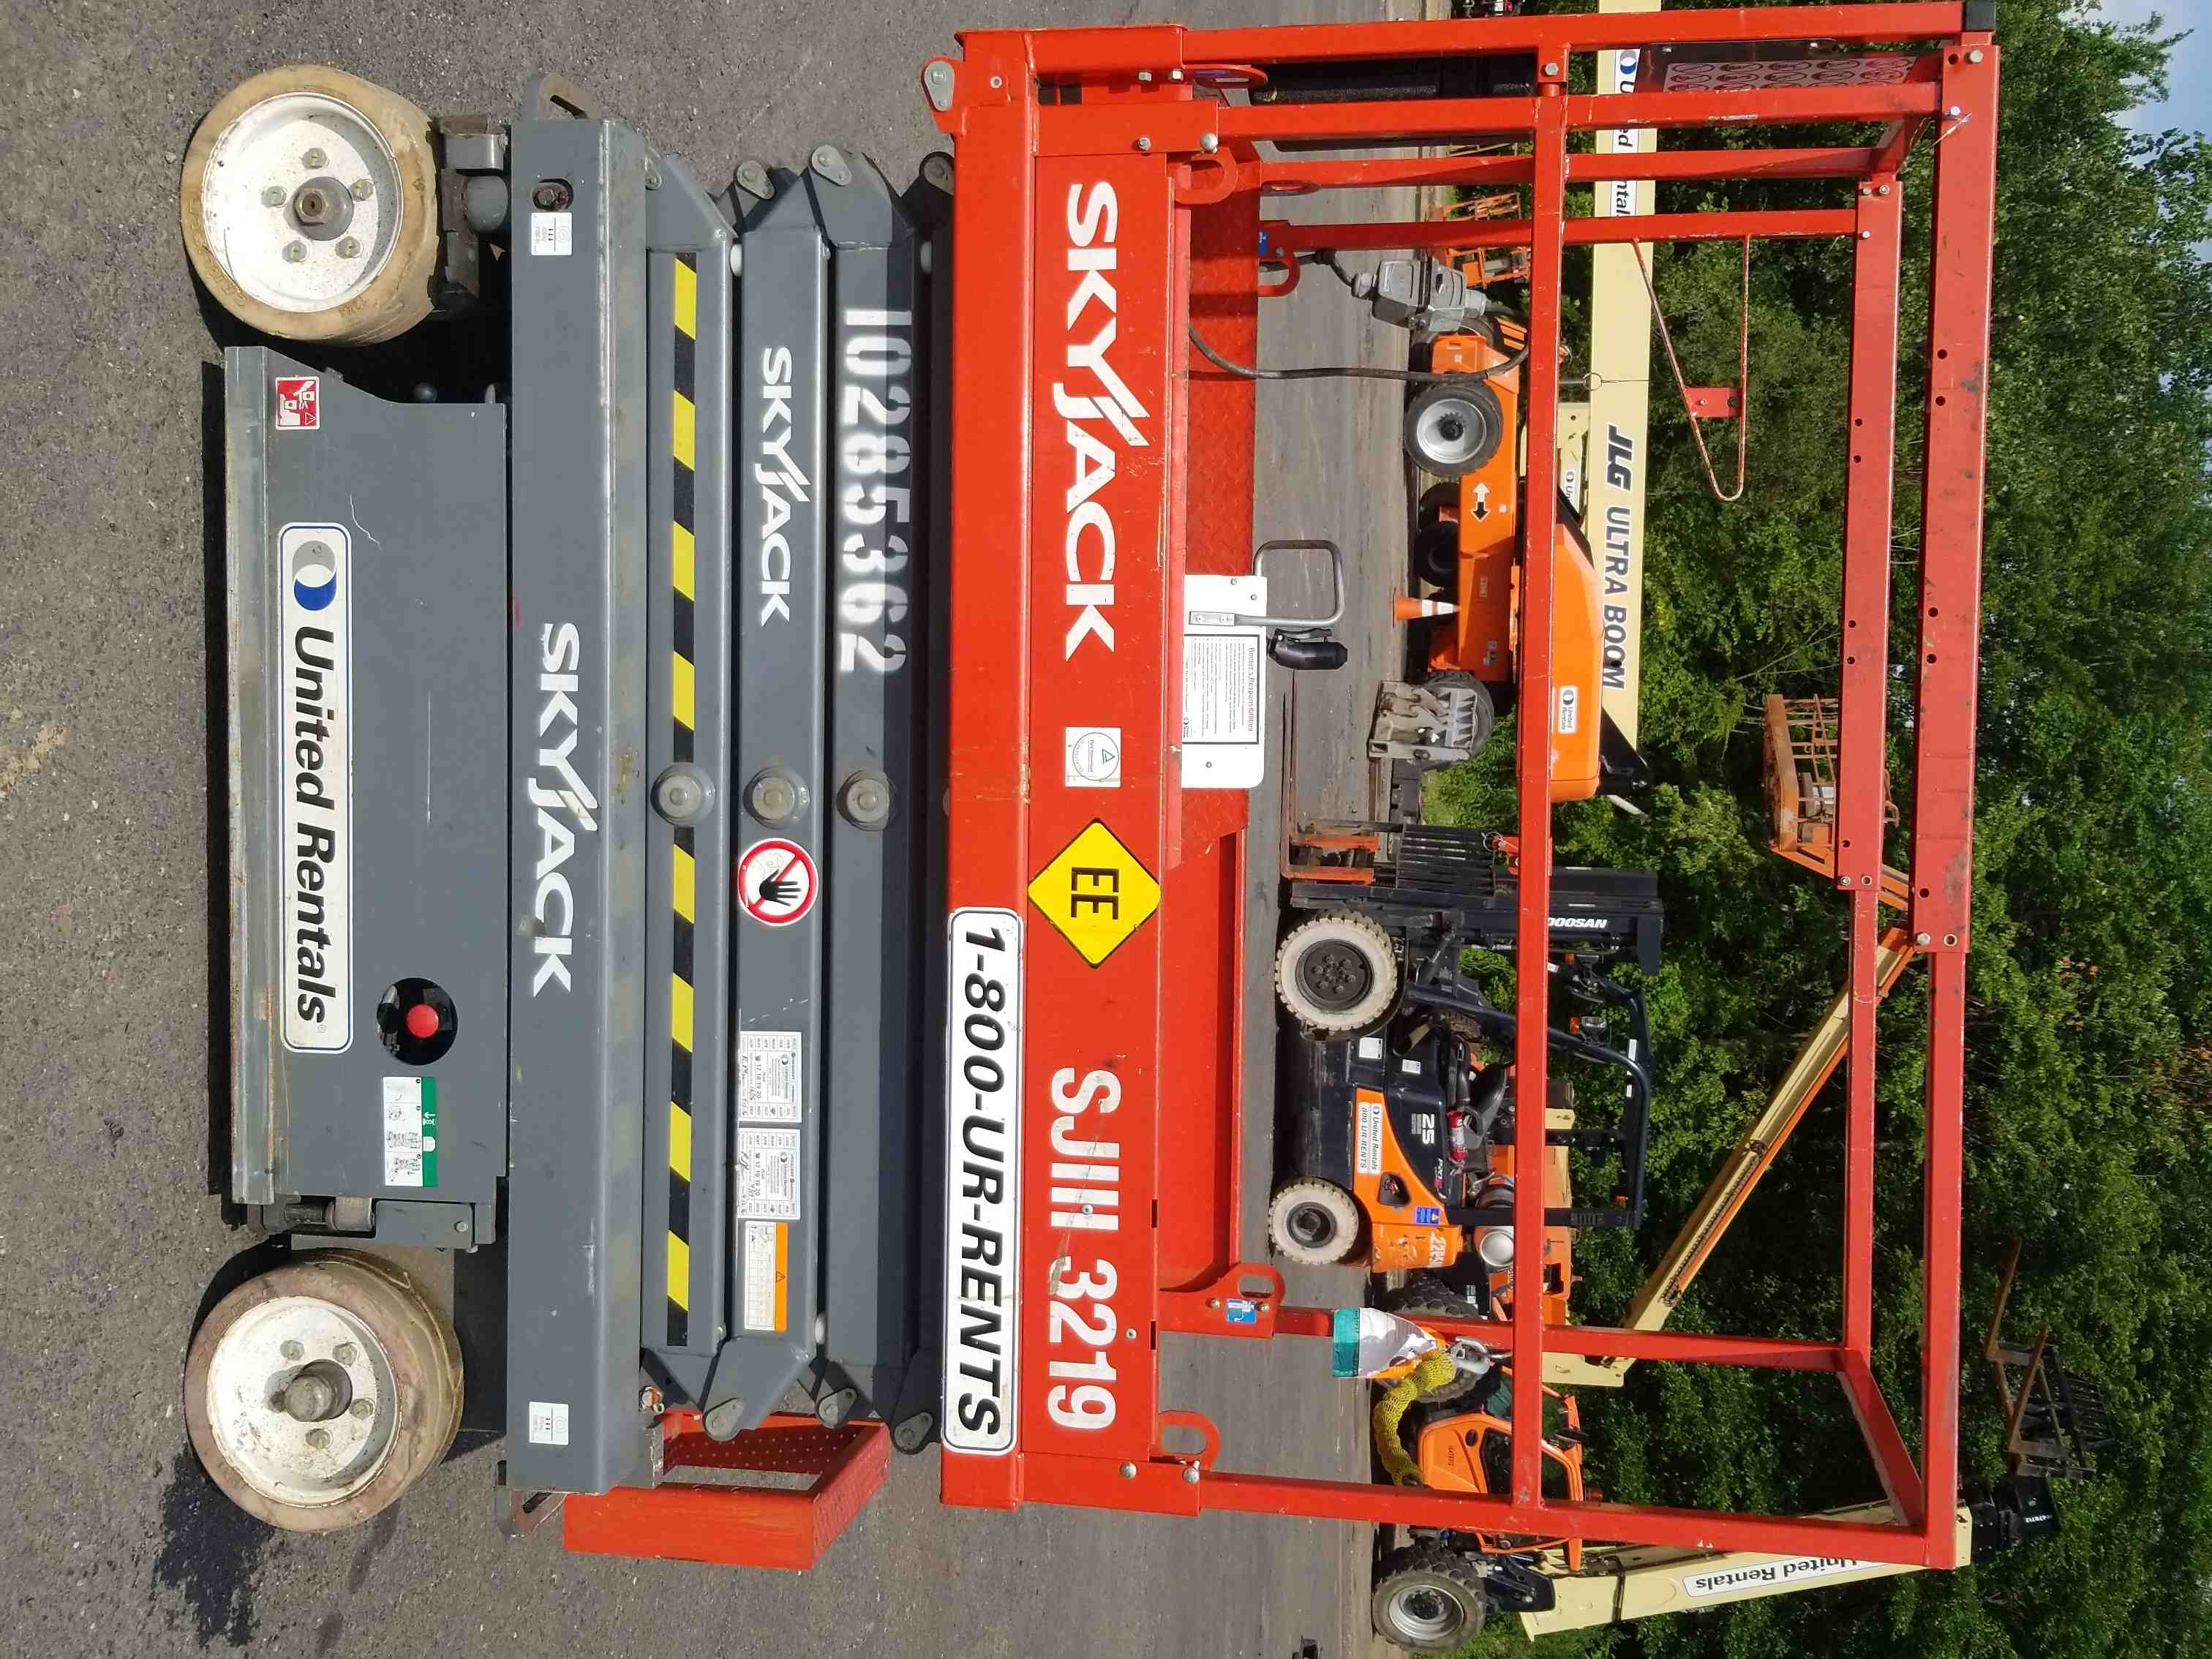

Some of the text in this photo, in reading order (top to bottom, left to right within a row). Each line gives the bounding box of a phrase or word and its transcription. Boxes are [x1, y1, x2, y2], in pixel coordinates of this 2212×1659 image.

[1618, 80, 1634, 147] Ued
[754, 346, 810, 626] SKYJACK
[840, 309, 912, 672] 10285362
[1053, 181, 1150, 661] SKYJACK
[1607, 425, 1633, 492] JLG
[1603, 507, 1630, 689] ULTRA BOOM
[295, 625, 336, 1023] United Rentals
[529, 622, 598, 997] SKYJACK
[1071, 867, 1119, 920] EE
[958, 927, 1006, 1434] 1-800-UR-RENTS
[1422, 1113, 1435, 1144] 25
[1048, 1256, 1117, 1430] 3219
[1696, 1568, 1776, 1590] Rentals
